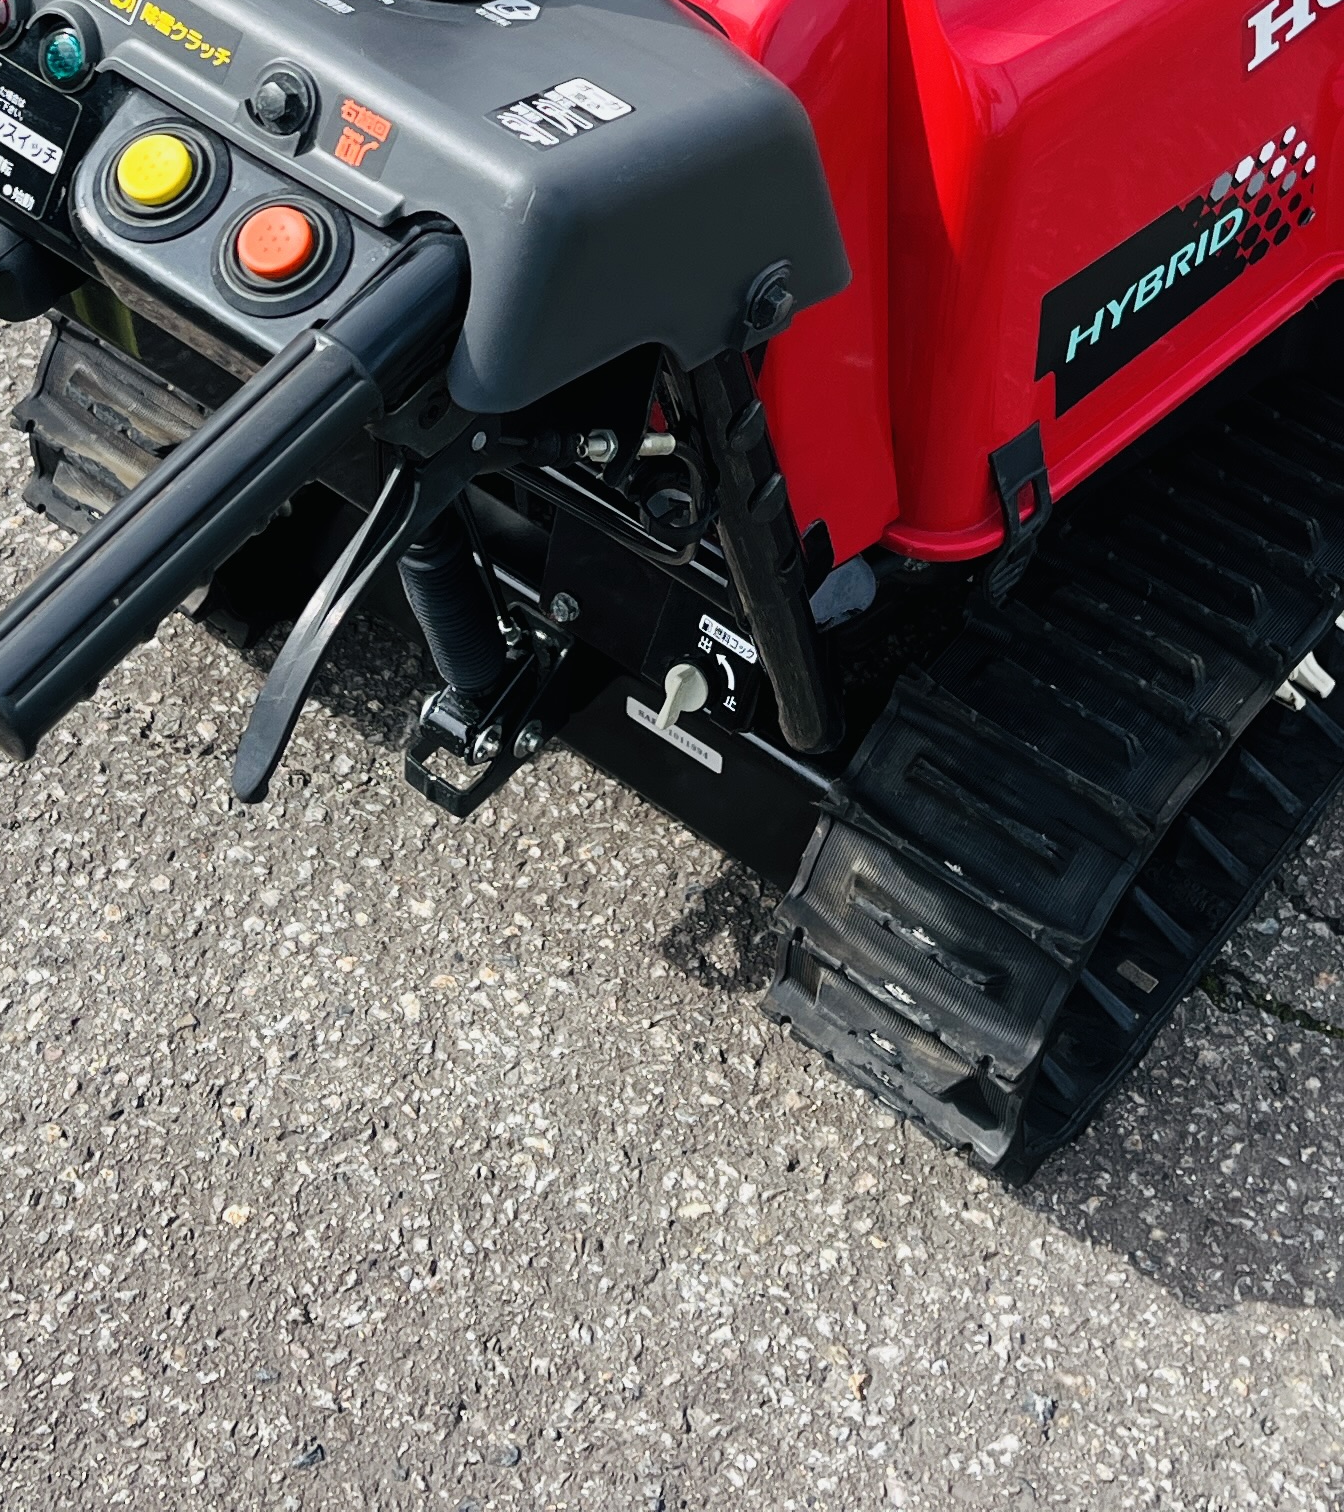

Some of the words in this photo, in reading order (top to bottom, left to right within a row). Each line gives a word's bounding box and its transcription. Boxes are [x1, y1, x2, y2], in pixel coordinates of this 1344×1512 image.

[1065, 206, 1243, 363] HYBRID
[697, 635, 713, 654] 出
[722, 695, 737, 712] 止
